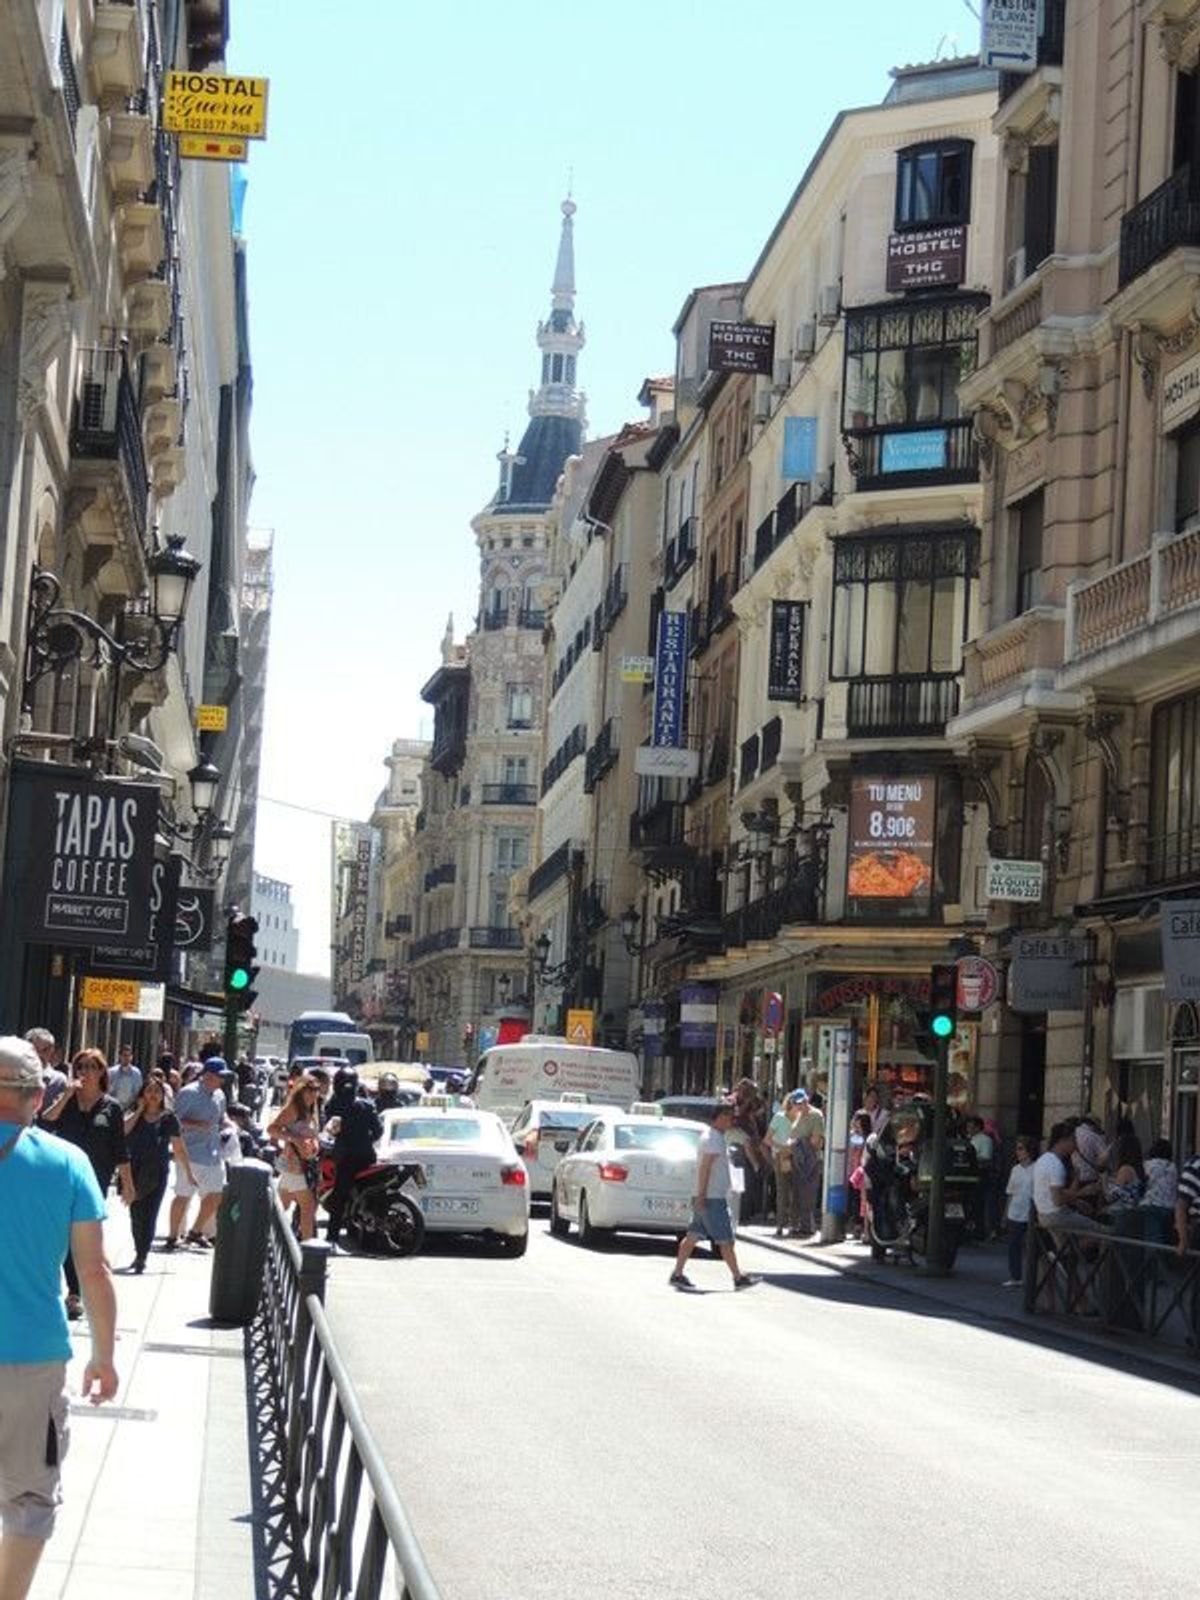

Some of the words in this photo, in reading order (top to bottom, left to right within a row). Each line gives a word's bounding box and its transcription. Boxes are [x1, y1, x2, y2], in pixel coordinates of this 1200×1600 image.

[992, 11, 1028, 23] PLAYA
[171, 74, 262, 97] HOSTAL
[176, 94, 253, 117] Guerra
[889, 238, 961, 257] HOSTEL
[905, 260, 942, 275] THC
[712, 331, 770, 346] HOSTEL
[787, 606, 801, 686] ESMERALDA
[658, 614, 680, 748] RESTAURANTE
[868, 783, 885, 801] TU
[54, 792, 137, 860] TAPAS
[52, 858, 129, 896] COFFEE
[990, 876, 1041, 889] ALQUILA
[52, 903, 91, 917] MARKET
[89, 981, 135, 995] GUERRA
